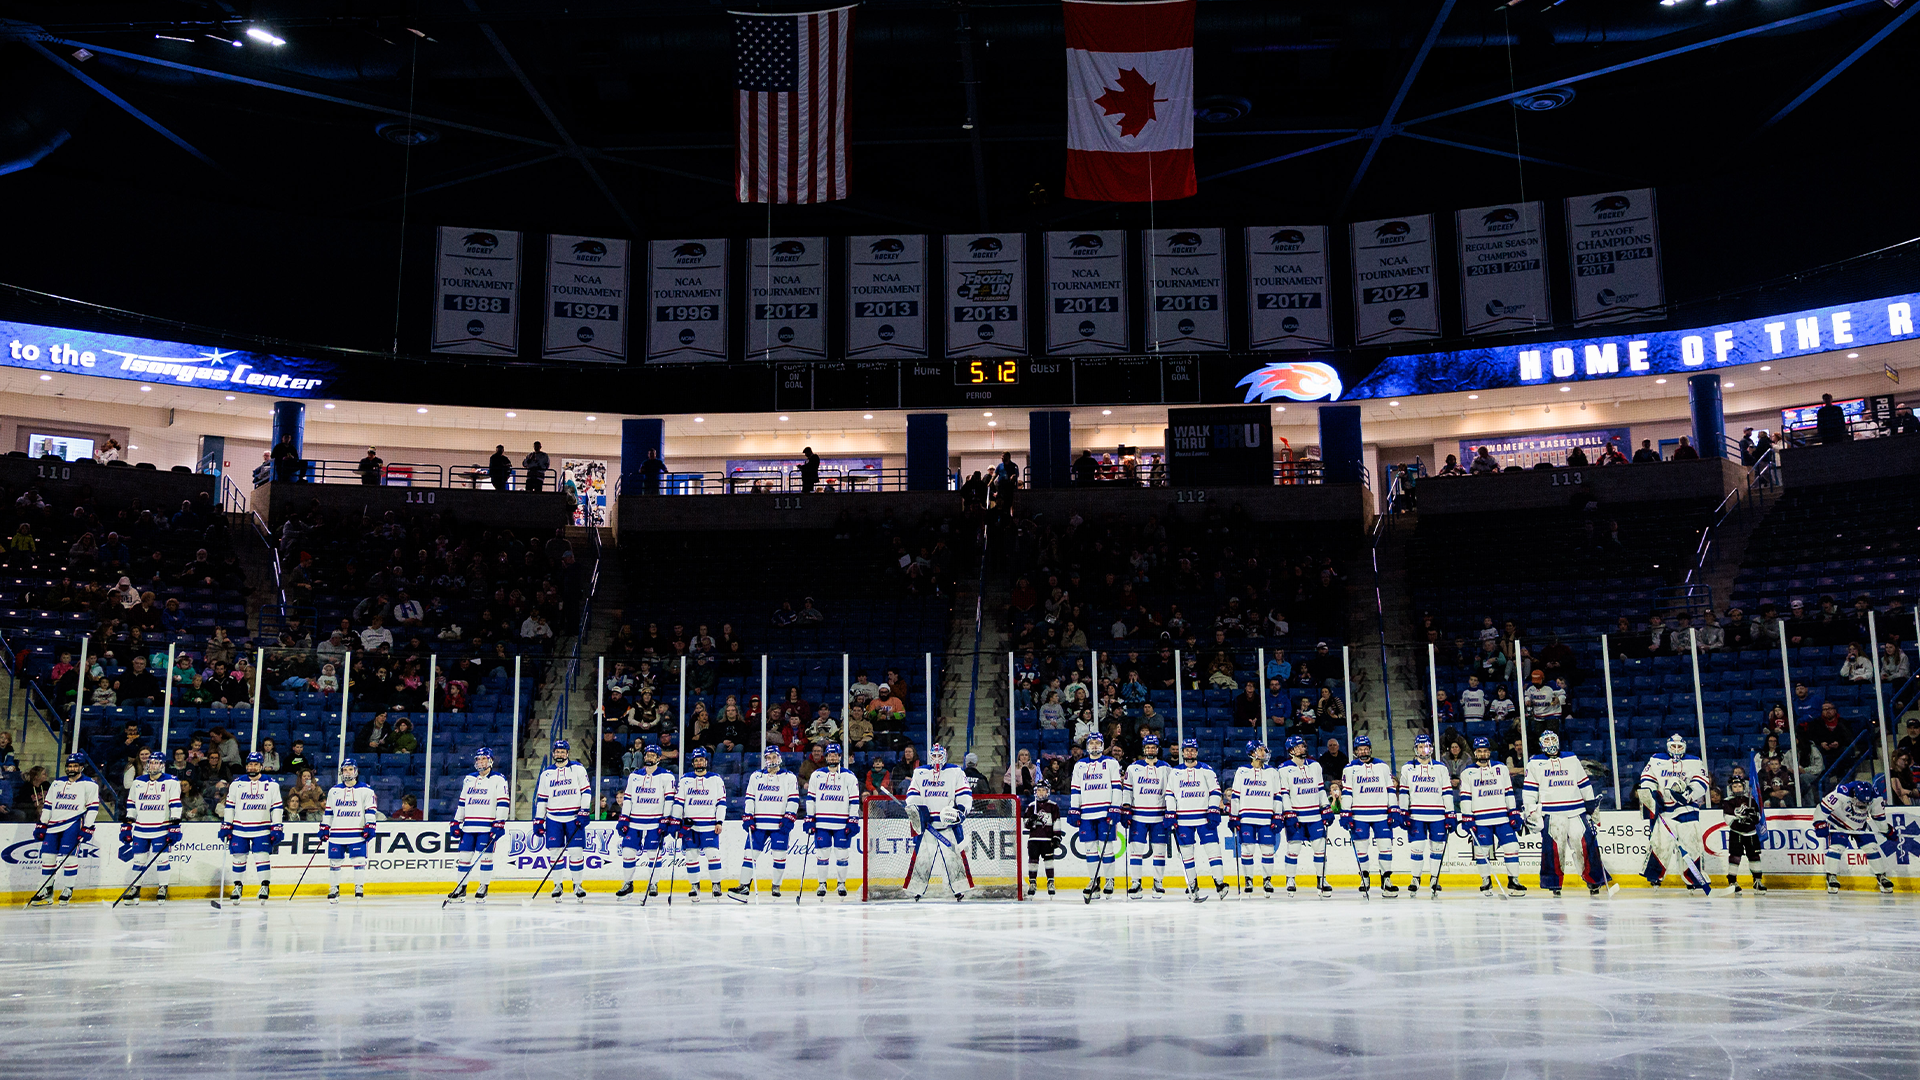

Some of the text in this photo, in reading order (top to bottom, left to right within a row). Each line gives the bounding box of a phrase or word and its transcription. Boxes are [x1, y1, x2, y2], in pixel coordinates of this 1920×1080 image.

[1598, 210, 1624, 219] HOCKEY
[1488, 224, 1514, 232] HOCKEY
[1591, 227, 1634, 238] PLAYOFF
[1380, 236, 1405, 244] HOCKEY
[1465, 237, 1538, 252] REGULAR SEASON
[1576, 234, 1650, 251] CHAMPIONS
[1379, 256, 1408, 266] NCAA
[1478, 250, 1528, 261] CHAMPIONS
[1582, 249, 1648, 264] 2013 2014
[464, 266, 493, 276] NCAA
[1170, 267, 1199, 276] NCAA
[1274, 265, 1302, 274] NCAA
[1359, 265, 1430, 281] TOURNAMENT
[1471, 260, 1535, 275] 2013 2017
[1582, 265, 1609, 276] 2017
[574, 274, 602, 284] NCAA
[872, 274, 900, 282] NCAA
[966, 273, 1013, 284] FROZEN
[1072, 269, 1100, 278] NCAA
[442, 278, 514, 290] TOURNAMENT
[675, 277, 702, 286] NCAA
[773, 275, 800, 284] NCAA
[1051, 280, 1121, 290] TOURNAMENT
[1150, 278, 1220, 288] TOURNAMENT
[1253, 276, 1323, 286] TOURNAMENT
[552, 286, 622, 298] TOURNAMENT
[654, 289, 722, 298] TOURNAMENT
[752, 287, 821, 296] TOURNAMENT
[852, 285, 921, 294] TOURNAMENT
[1372, 284, 1420, 302] 2022
[454, 296, 502, 312] 1988
[1063, 299, 1111, 312] 2014
[1162, 297, 1210, 310] 2016
[1266, 294, 1314, 308] 2017
[563, 304, 610, 319] 1994
[665, 307, 711, 320] 1996
[764, 305, 811, 318] 2012
[863, 303, 910, 316] 2013
[962, 307, 1010, 320] 2013
[1519, 302, 1914, 381] HOME OF THE R
[9, 339, 322, 390] to the Tsongas Center
[1030, 364, 1060, 373] GUEST
[914, 367, 941, 375] HOME
[1174, 425, 1210, 437] WALK
[1174, 437, 1206, 449] THRU
[1486, 437, 1603, 452] WOMEN'S BASKETBALL
[37, 465, 70, 480] 110
[1552, 472, 1582, 486] 113
[406, 492, 436, 504] 110
[1177, 490, 1206, 503] 112
[775, 498, 801, 509] 111
[264, 783, 269, 791] C
[1139, 787, 1163, 795] LOWELL
[1415, 785, 1439, 793] LOWELL
[56, 792, 77, 800] UMASS
[553, 789, 577, 797] LOWELL
[759, 794, 783, 802] LOWELL
[1478, 789, 1503, 797] LOWELL
[55, 802, 79, 810] LOWELL
[242, 802, 266, 810] LOWELL
[272, 832, 461, 854] HETAGE
